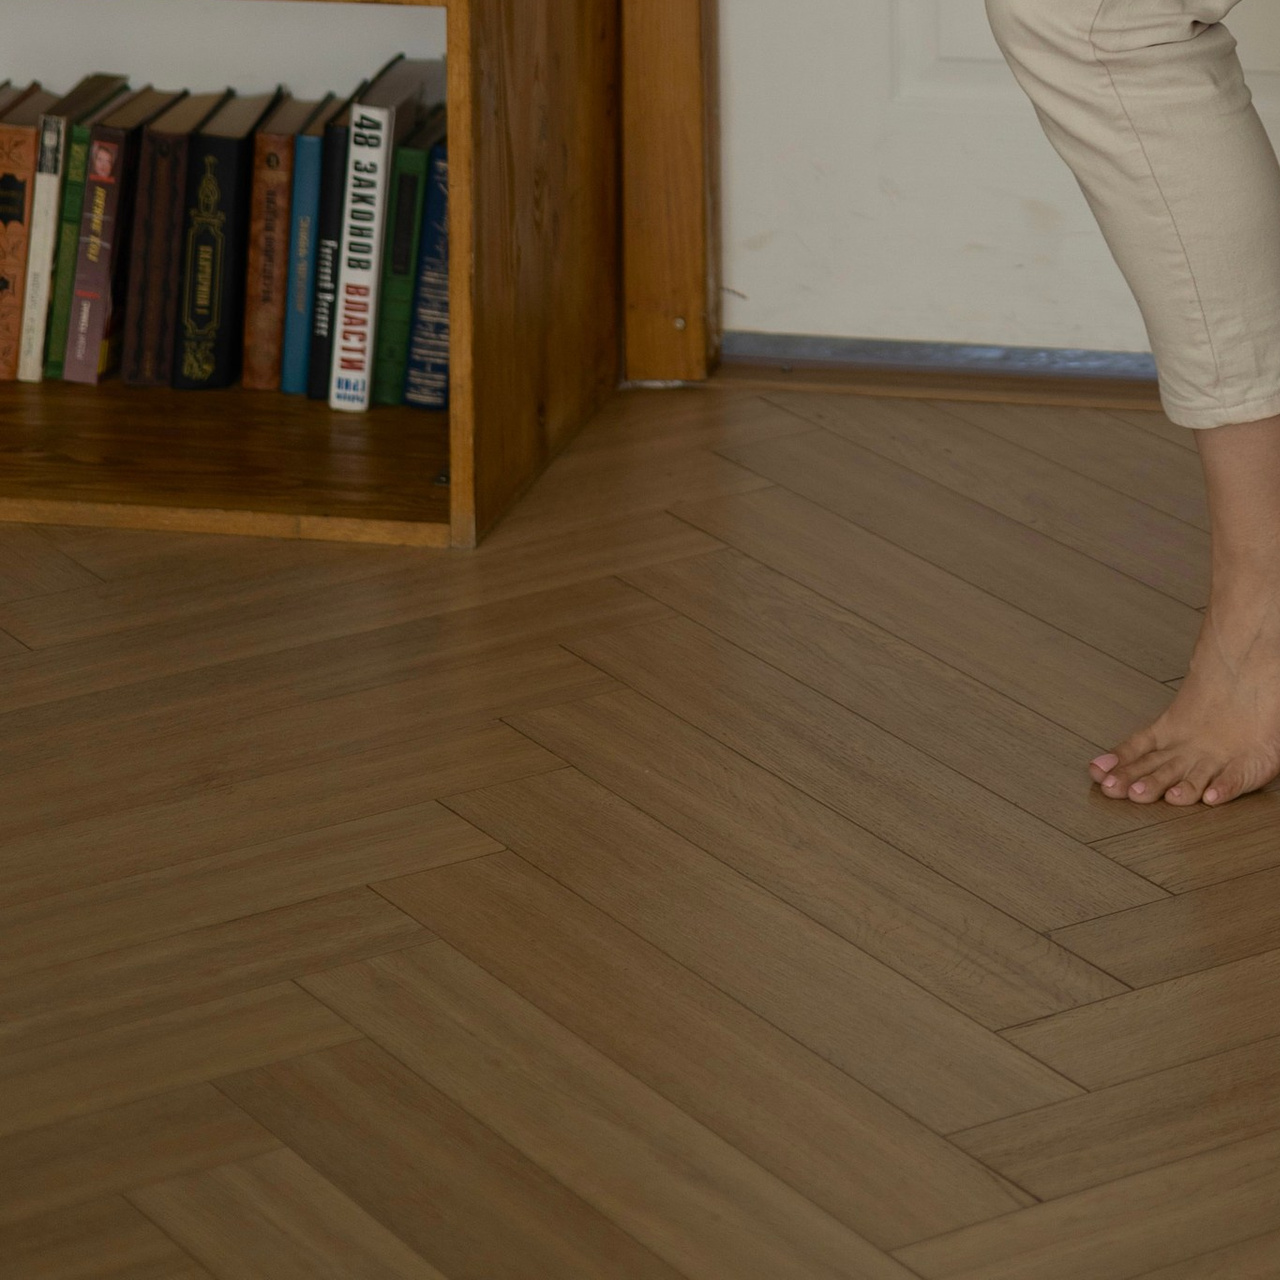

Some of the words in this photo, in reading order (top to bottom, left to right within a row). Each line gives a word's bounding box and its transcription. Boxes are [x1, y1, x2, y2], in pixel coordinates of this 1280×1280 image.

[351, 114, 384, 149] 48
[345, 159, 380, 272] ЗАКОНОВ
[338, 283, 372, 372] ВЛАСТИ
